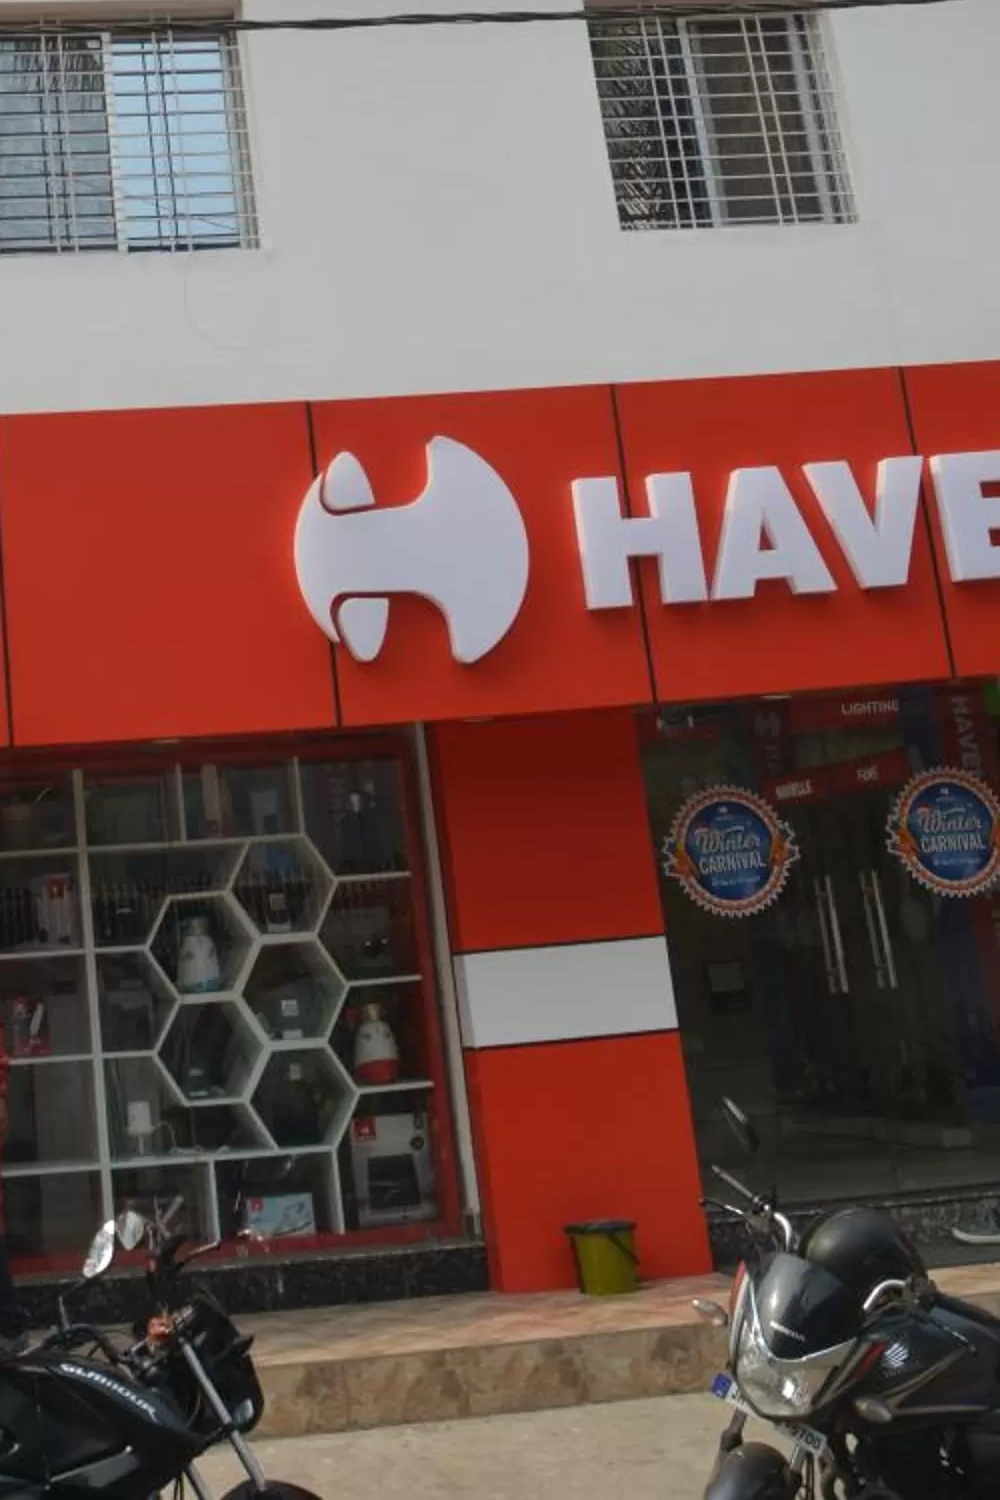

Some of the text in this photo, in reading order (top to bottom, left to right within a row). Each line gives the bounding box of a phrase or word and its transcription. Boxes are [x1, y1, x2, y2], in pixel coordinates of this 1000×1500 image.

[571, 450, 1000, 611] HAVE
[916, 806, 983, 834] Winter
[920, 831, 987, 853] CARNIVAL
[700, 851, 767, 875] CARNIVAL
